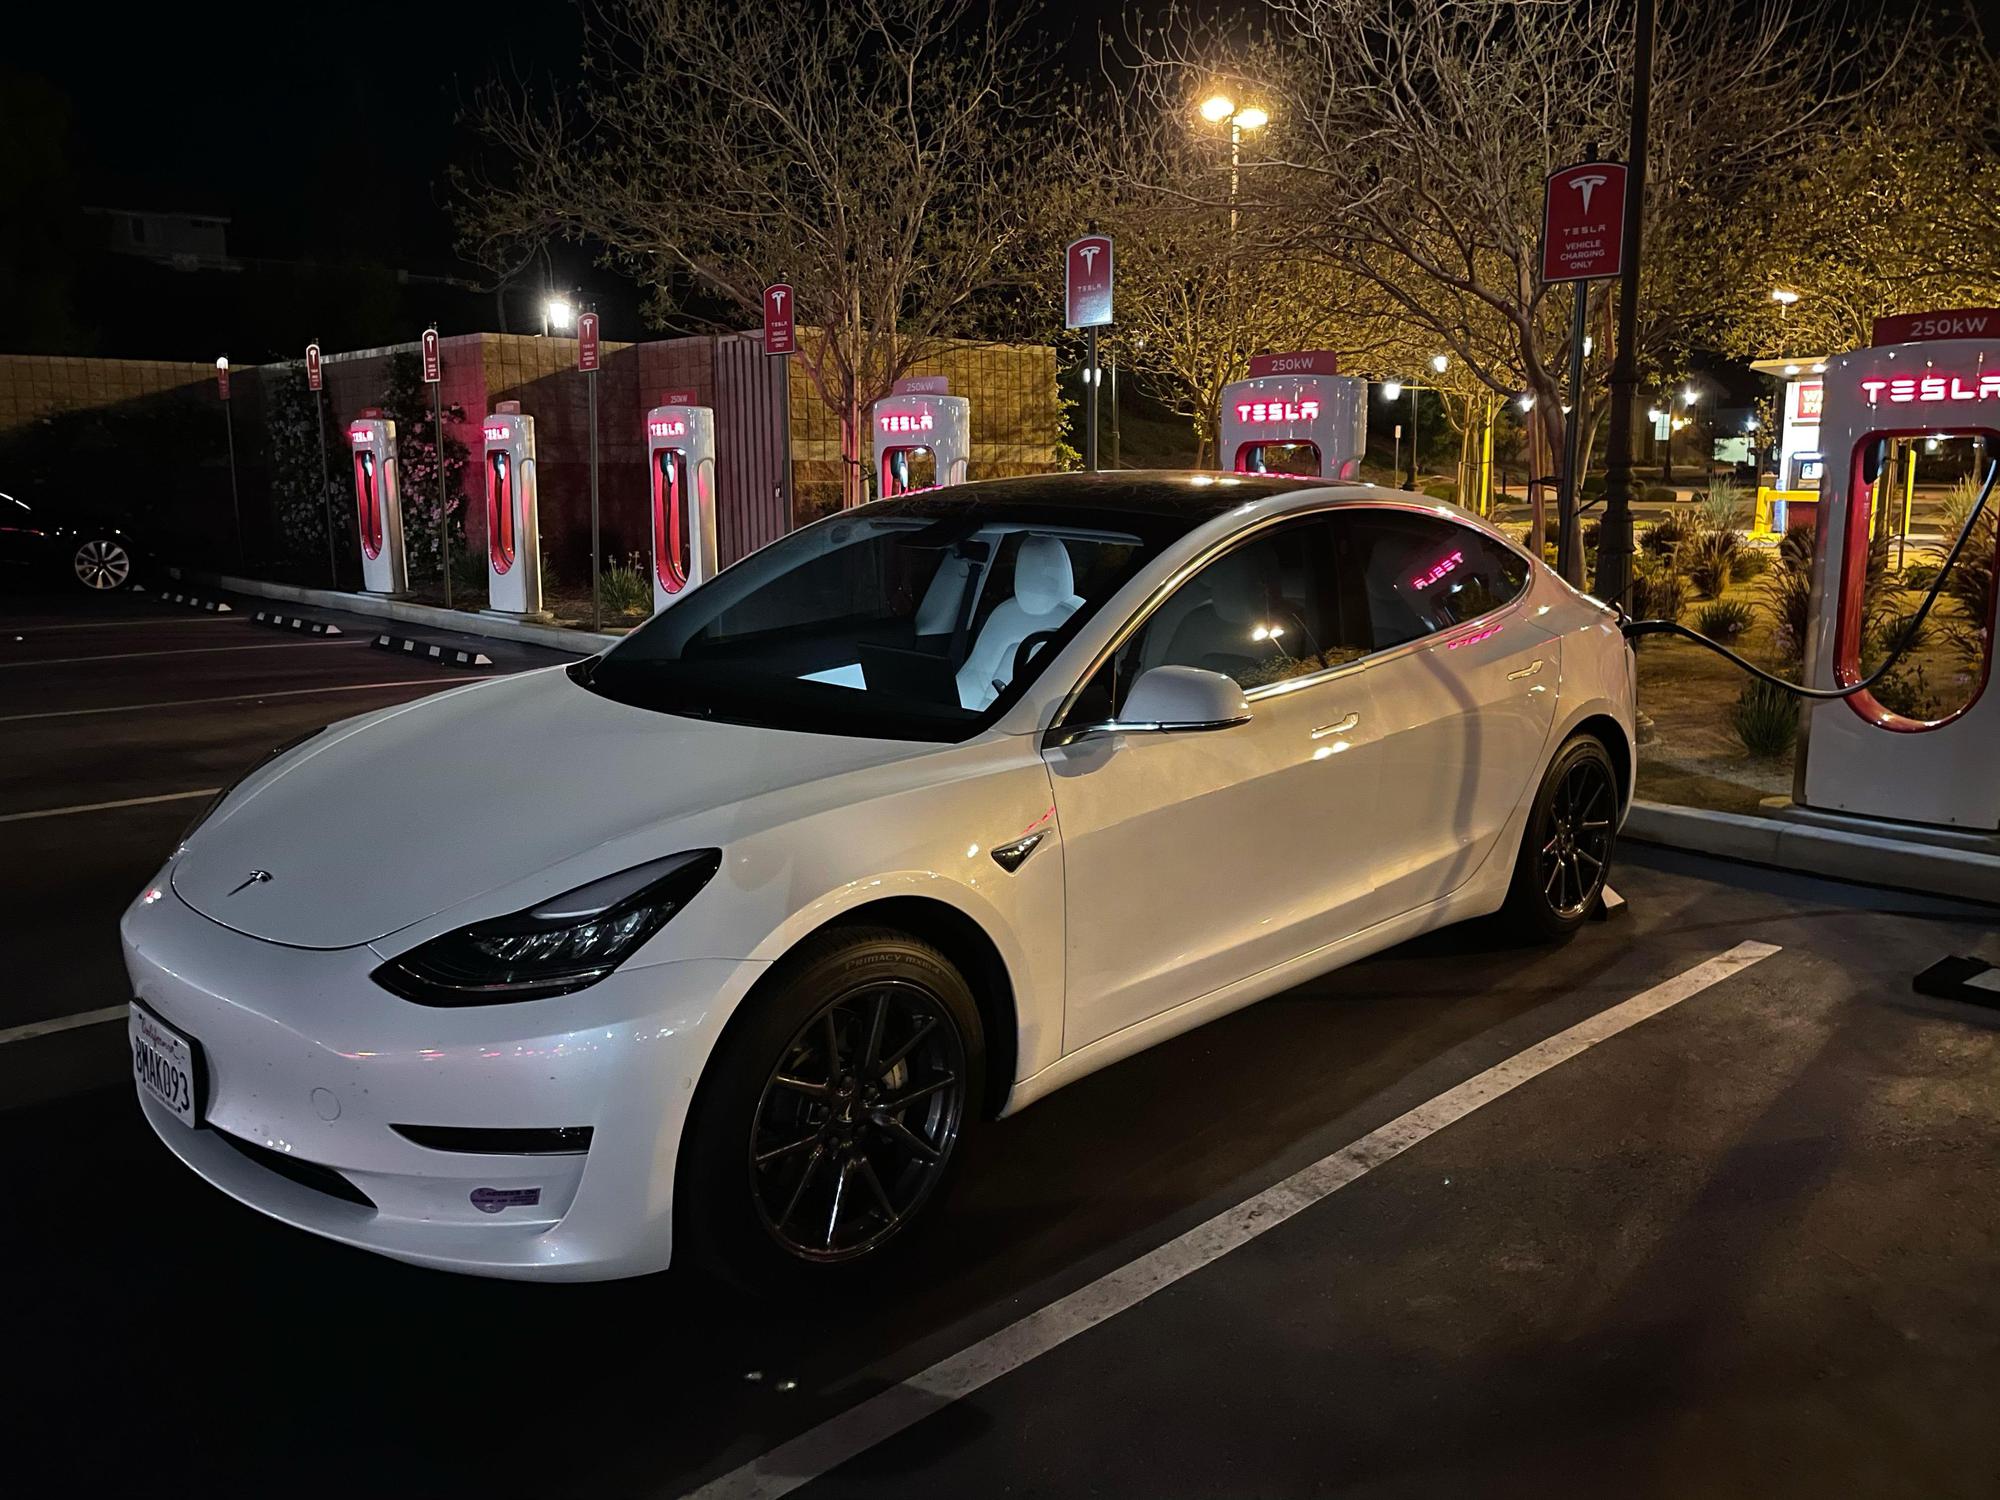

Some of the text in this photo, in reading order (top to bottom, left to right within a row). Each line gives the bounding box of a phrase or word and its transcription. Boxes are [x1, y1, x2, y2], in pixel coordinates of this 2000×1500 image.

[1563, 225, 1606, 236] TESLA
[1566, 240, 1601, 250] VEHICLE
[1560, 249, 1605, 261] CHARGING
[1570, 261, 1593, 270] ONLY
[1910, 317, 1989, 337] 250kW
[1271, 357, 1314, 371] 250kW
[906, 381, 935, 392] 250kW
[1861, 376, 2000, 403] TESLA
[1238, 401, 1320, 421] TESLA
[650, 422, 684, 436] TESLA
[881, 415, 933, 431] TESLA
[136, 1036, 190, 1111] 8MAK093
